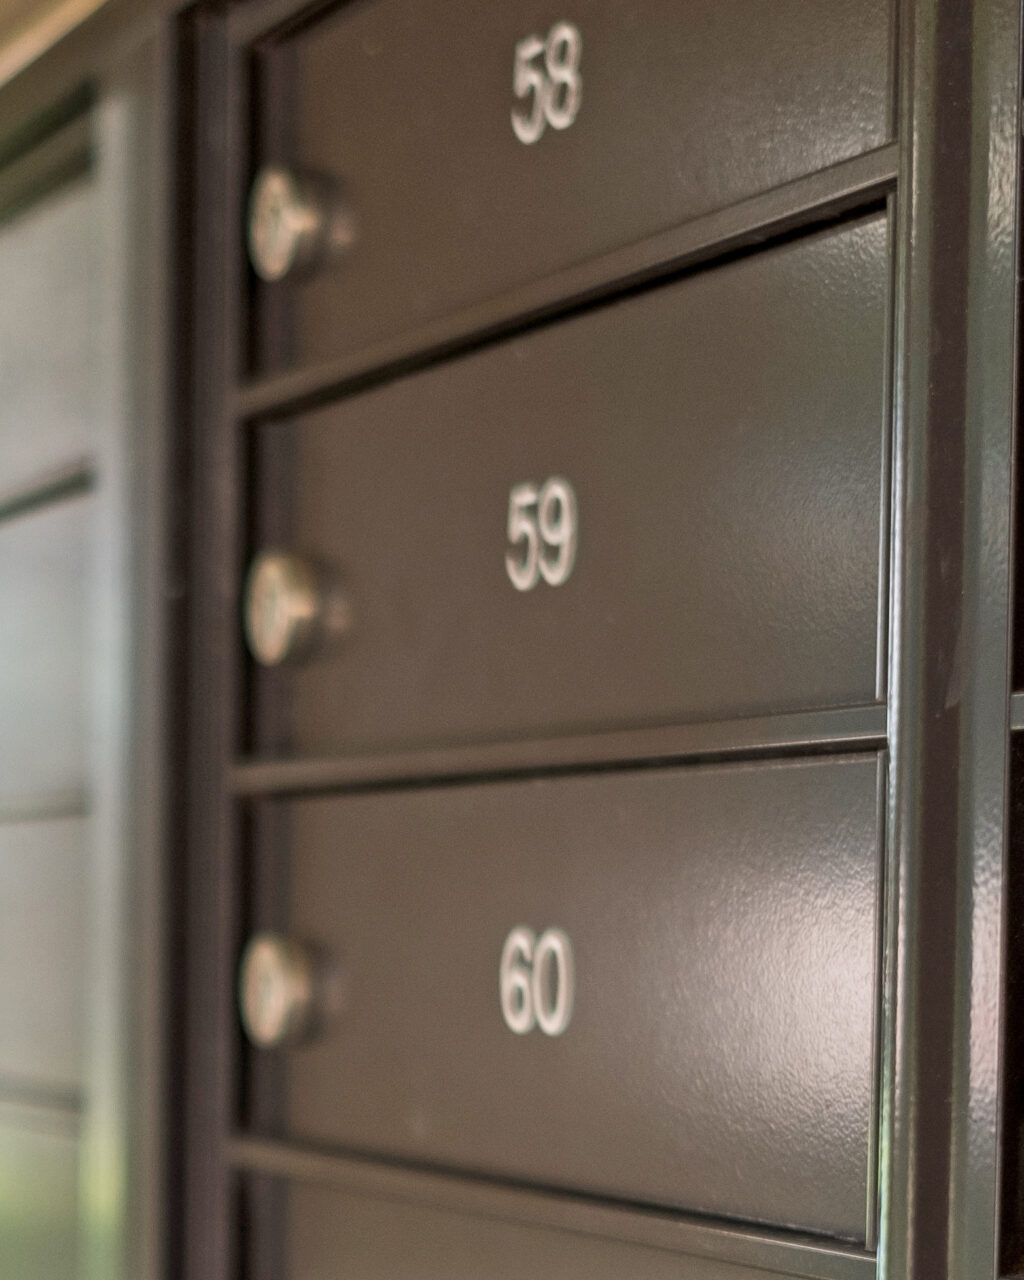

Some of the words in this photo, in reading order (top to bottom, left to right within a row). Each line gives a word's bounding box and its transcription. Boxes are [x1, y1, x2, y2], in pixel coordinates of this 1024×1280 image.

[510, 21, 581, 146] 58
[505, 477, 578, 592] 59
[499, 927, 572, 1037] 60
